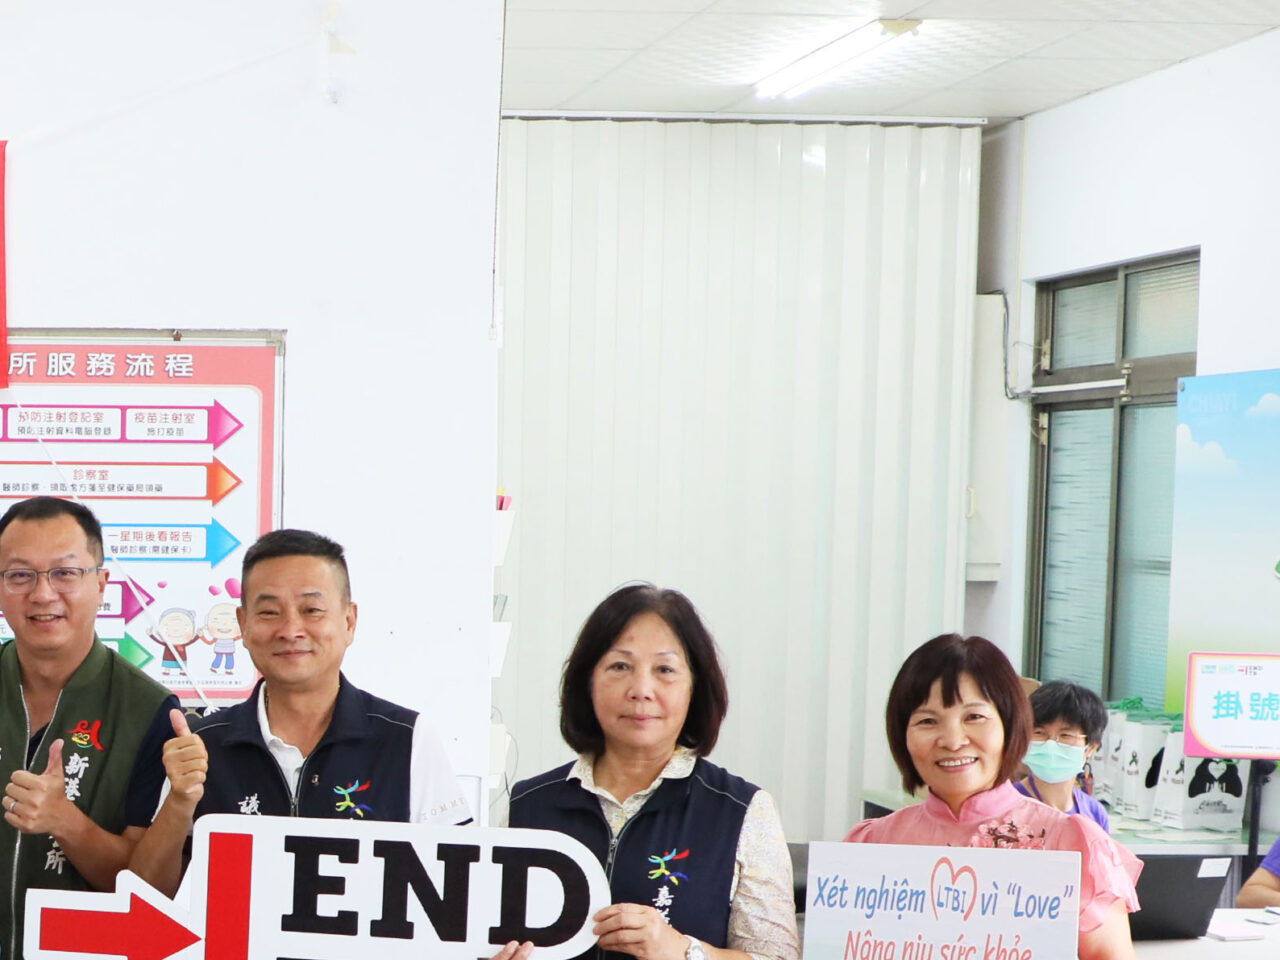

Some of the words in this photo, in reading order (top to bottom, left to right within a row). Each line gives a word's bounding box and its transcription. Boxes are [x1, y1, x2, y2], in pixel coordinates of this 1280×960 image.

[8, 352, 194, 378] 所服務流程
[275, 835, 591, 948] END
[813, 875, 849, 908] Xét
[854, 875, 926, 920] nghiệm
[937, 885, 967, 914] LTBI
[981, 882, 999, 915] vì
